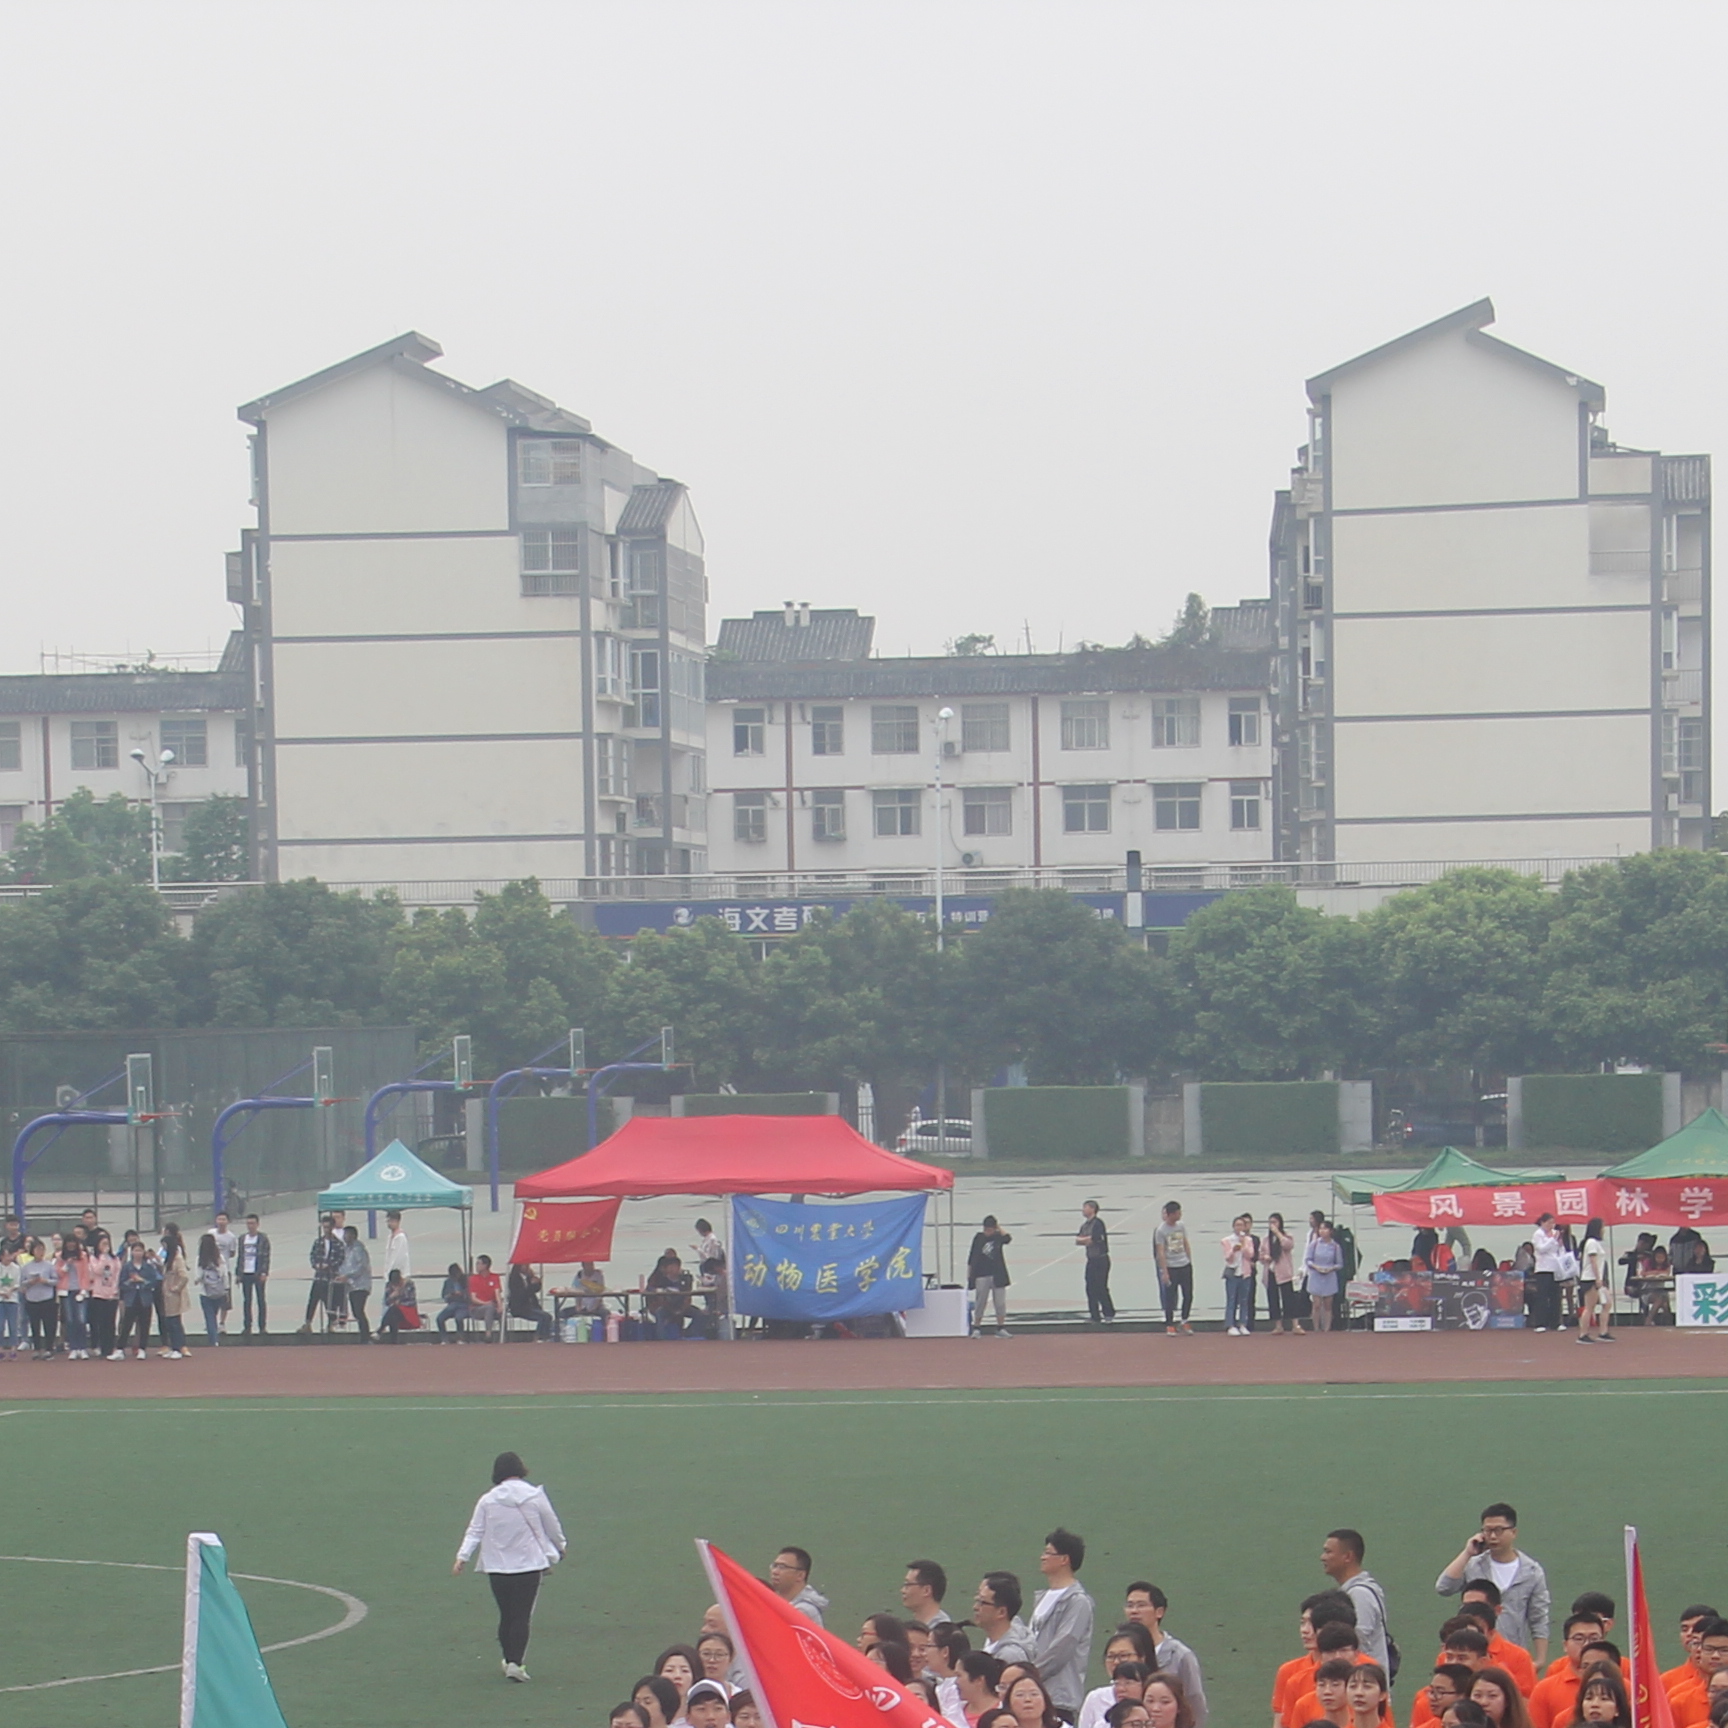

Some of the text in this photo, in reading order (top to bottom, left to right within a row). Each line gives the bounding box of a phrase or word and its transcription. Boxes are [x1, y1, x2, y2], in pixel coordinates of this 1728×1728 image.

[743, 1246, 913, 1293] 动物医学院
